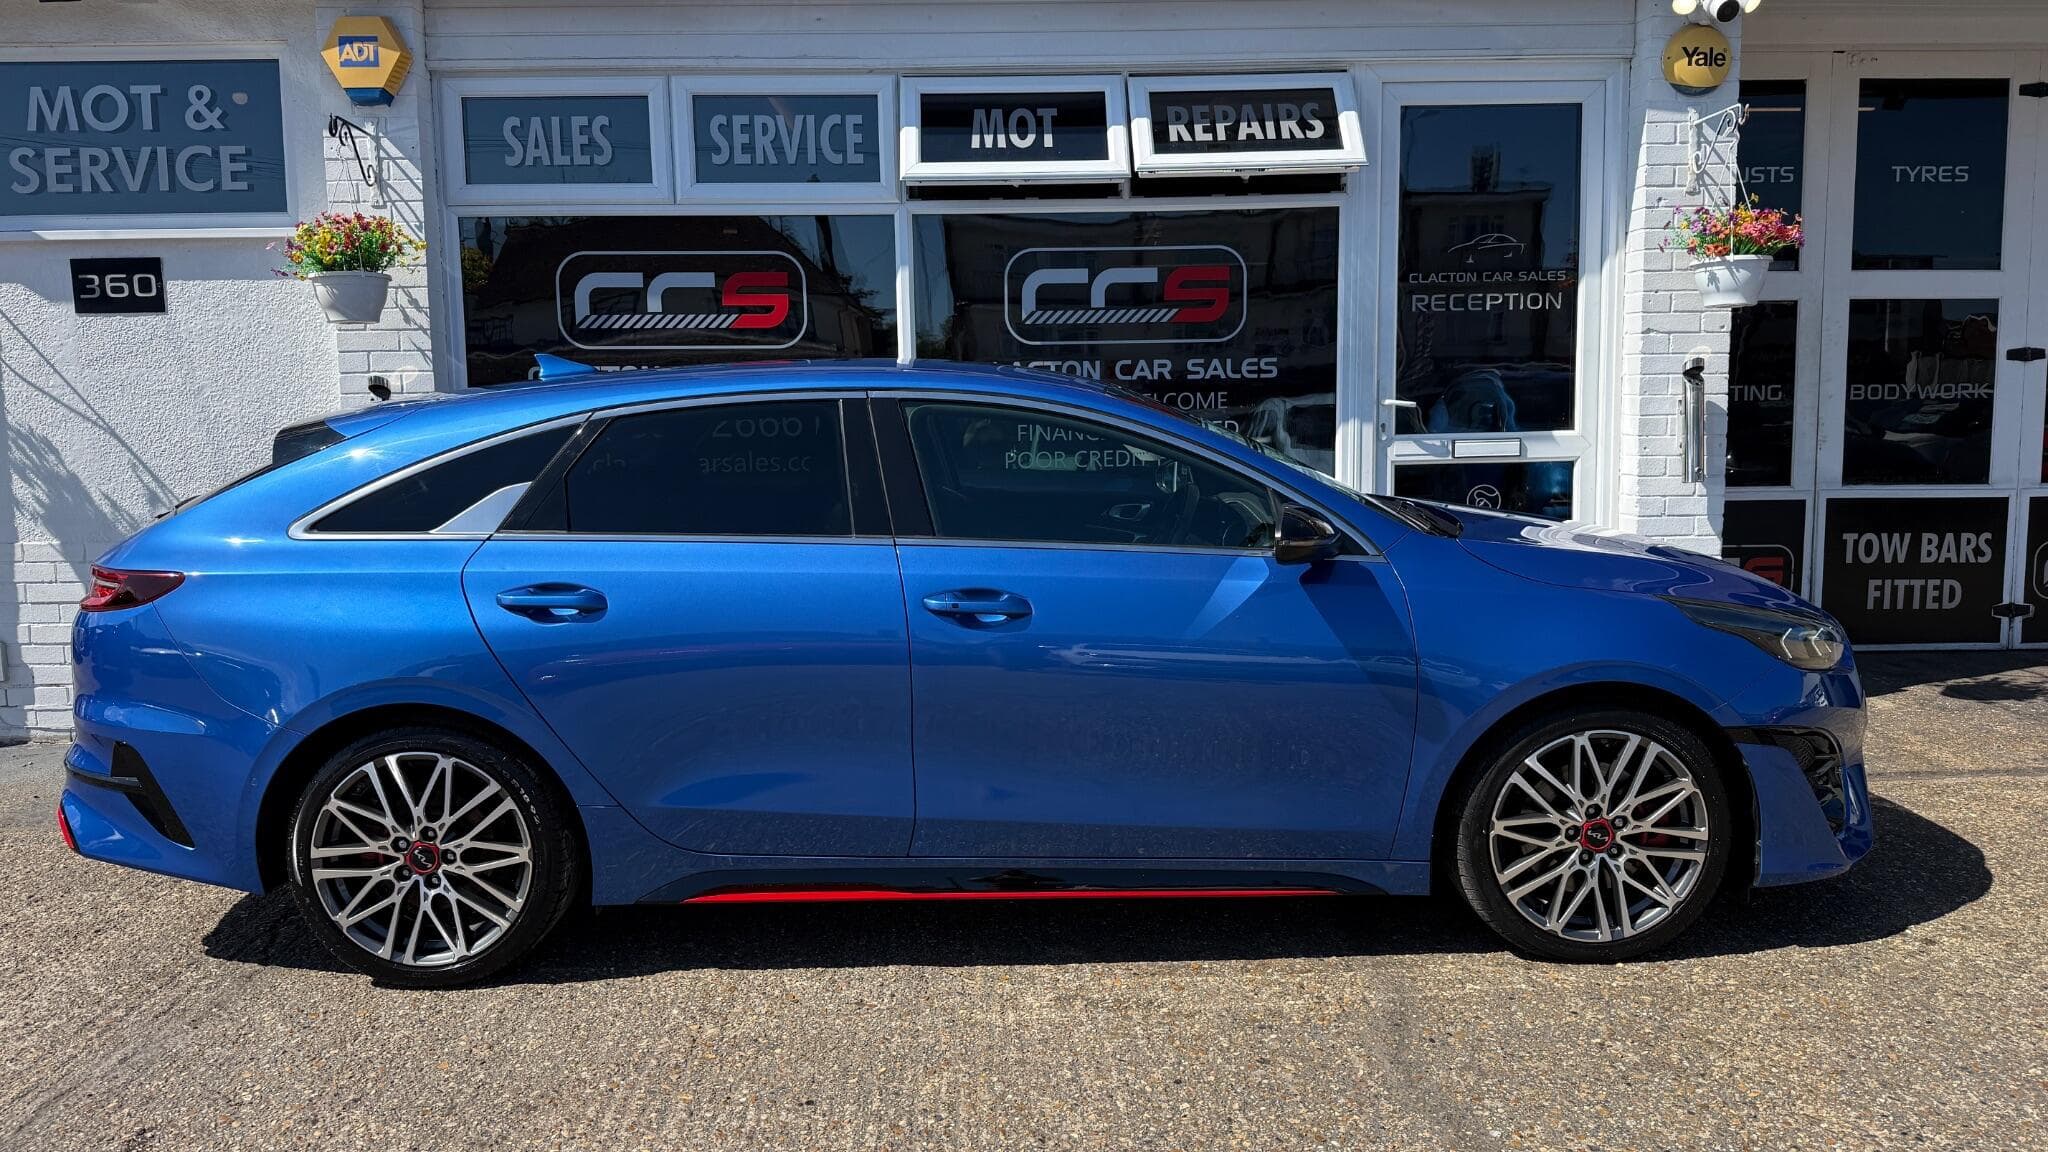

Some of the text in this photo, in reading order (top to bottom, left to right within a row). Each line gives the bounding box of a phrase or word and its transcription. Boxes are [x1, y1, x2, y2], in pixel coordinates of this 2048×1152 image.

[339, 40, 380, 65] ADT
[27, 84, 226, 133] MOT &
[1166, 101, 1325, 143] REPAIRS
[502, 115, 613, 167] SALES
[709, 113, 865, 166] SERVICE
[970, 107, 1058, 149] MOT
[8, 145, 252, 195] SERVICE
[1892, 165, 1970, 183] TYRES
[78, 273, 157, 299] 360
[1409, 269, 1567, 284] CLACTON CAR SALES
[1411, 291, 1563, 312] RECEPTION
[1115, 359, 1173, 380] CAR
[1187, 357, 1279, 380] SALES
[1850, 382, 1990, 400] BODYWORK
[1005, 451, 1066, 469] POOR
[1842, 531, 1993, 564] TOW BARS
[1866, 578, 1962, 610] FITTED
